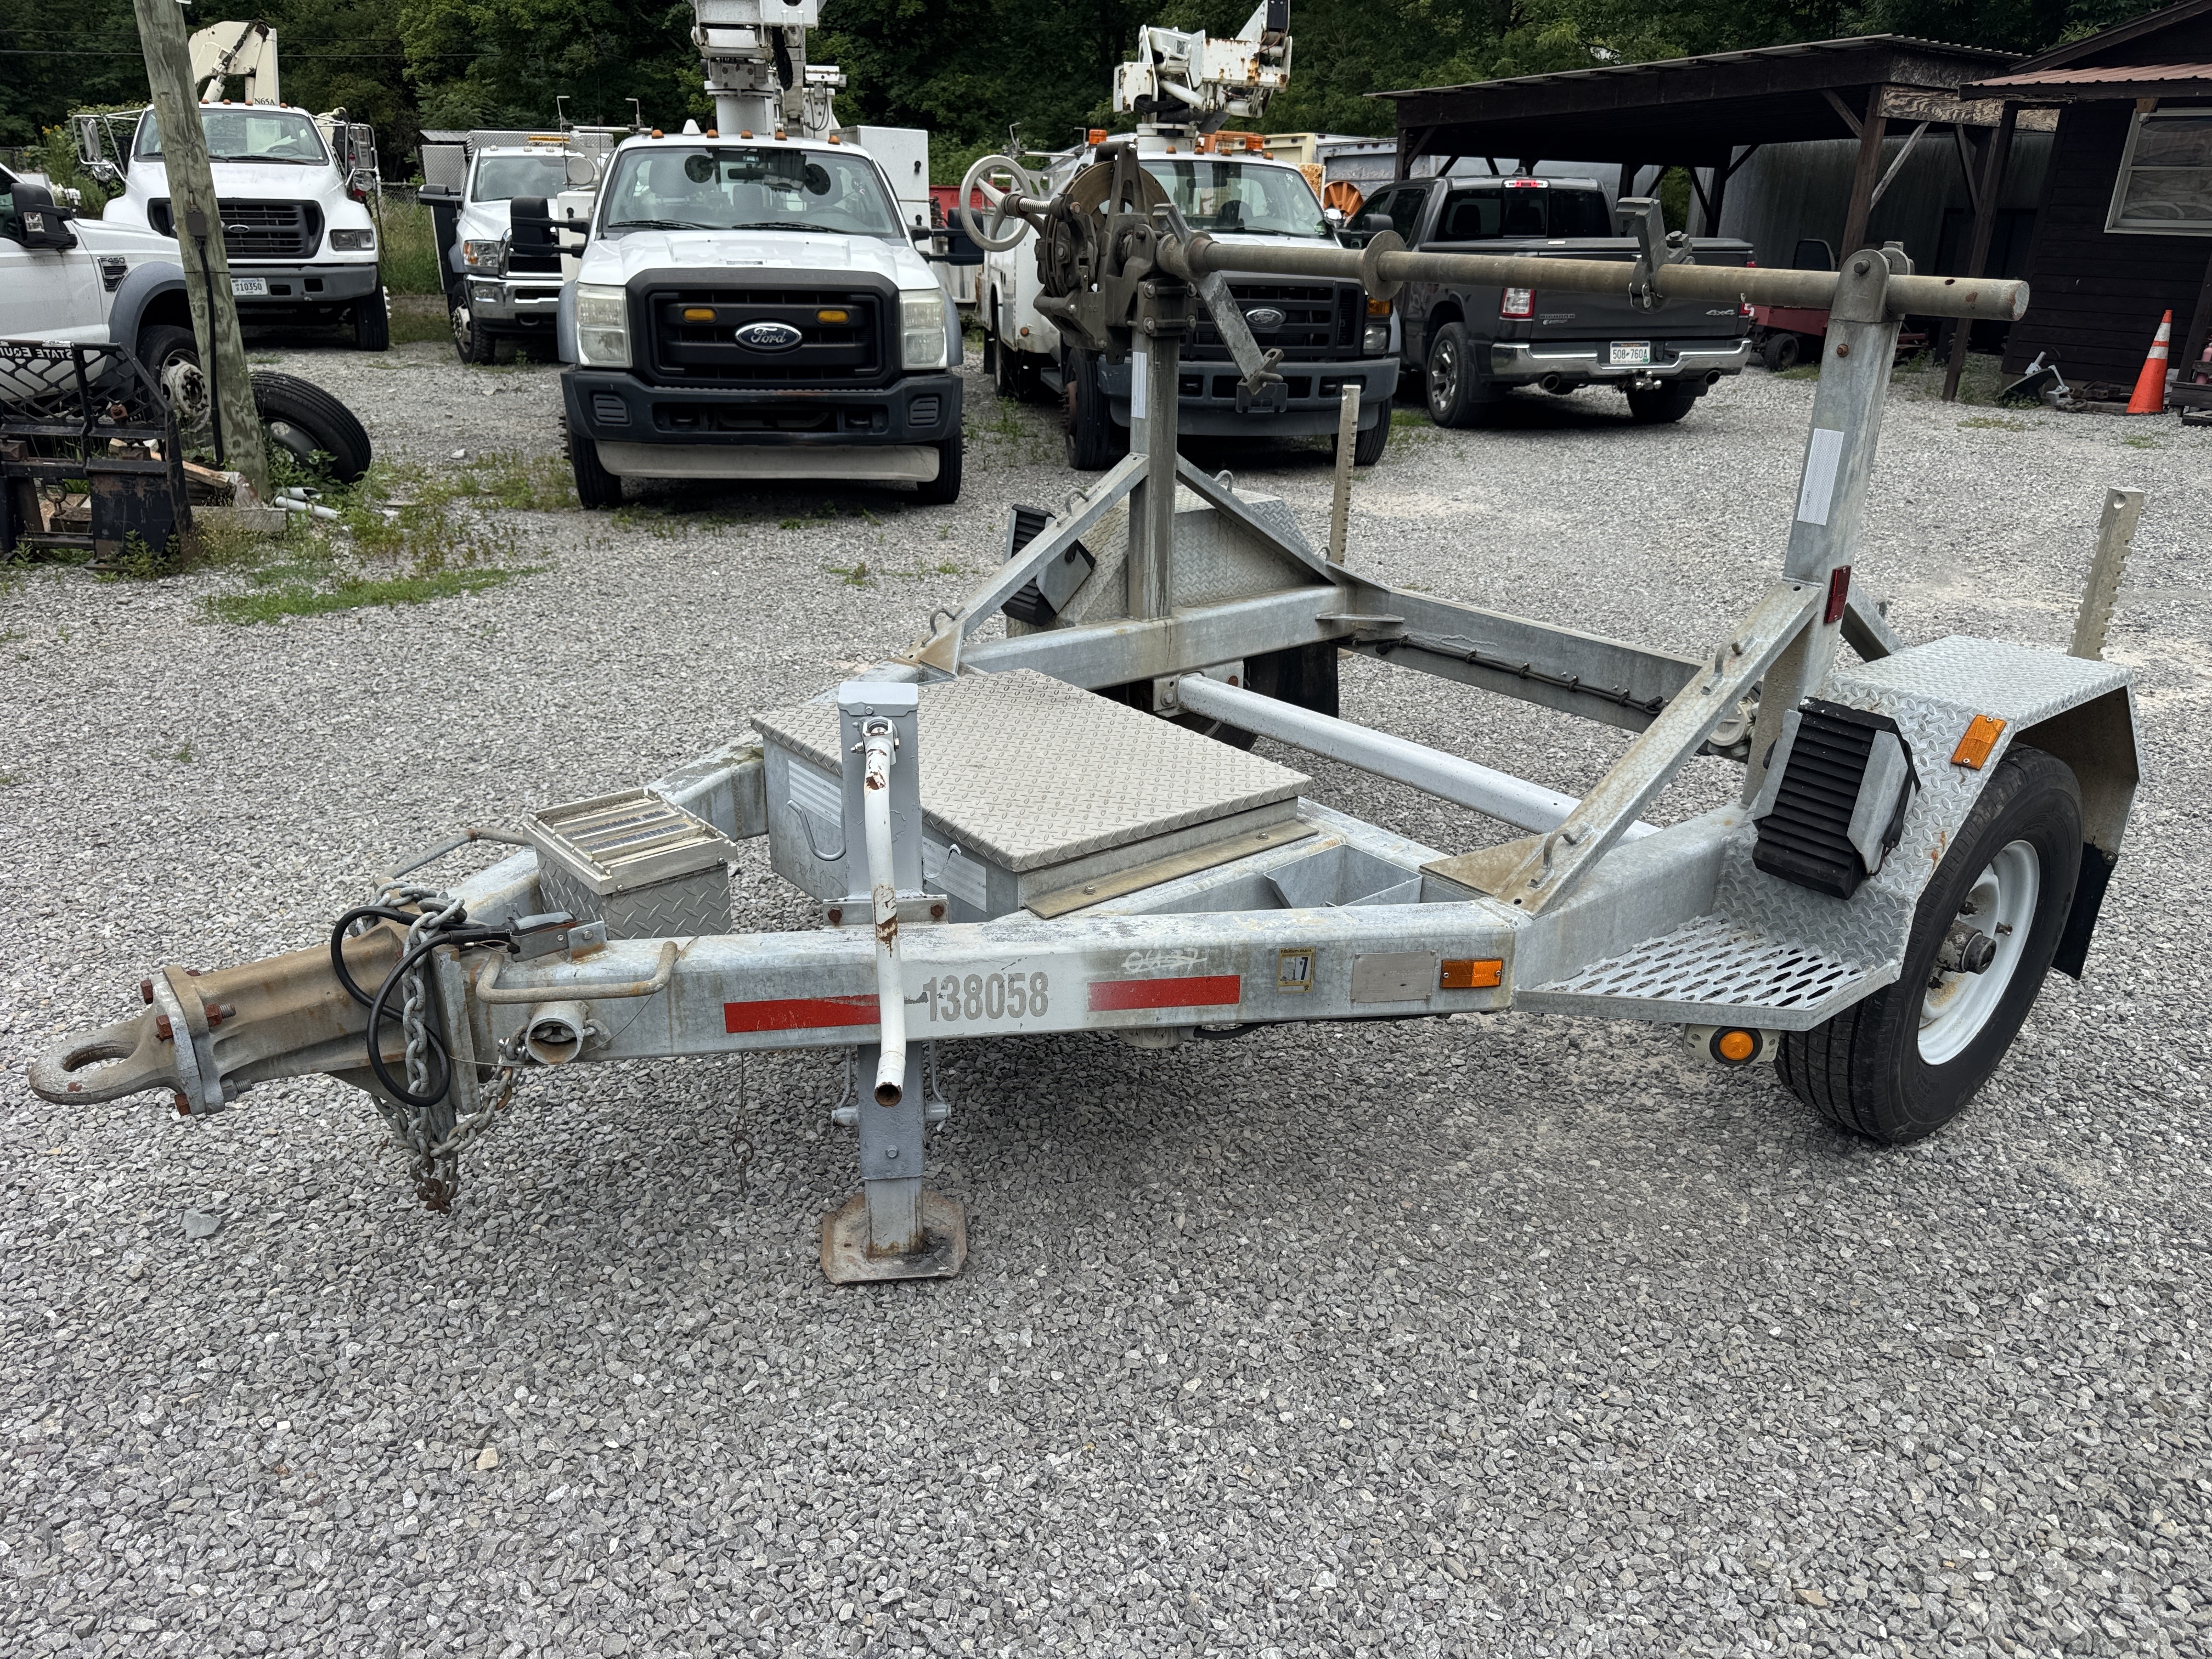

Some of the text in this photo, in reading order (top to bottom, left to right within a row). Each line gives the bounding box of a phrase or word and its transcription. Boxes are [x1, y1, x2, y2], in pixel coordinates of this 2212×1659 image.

[240, 283, 262, 291] 10350
[751, 326, 787, 343] Ford
[1301, 957, 1308, 980] 7
[923, 971, 1048, 1022] 138058
